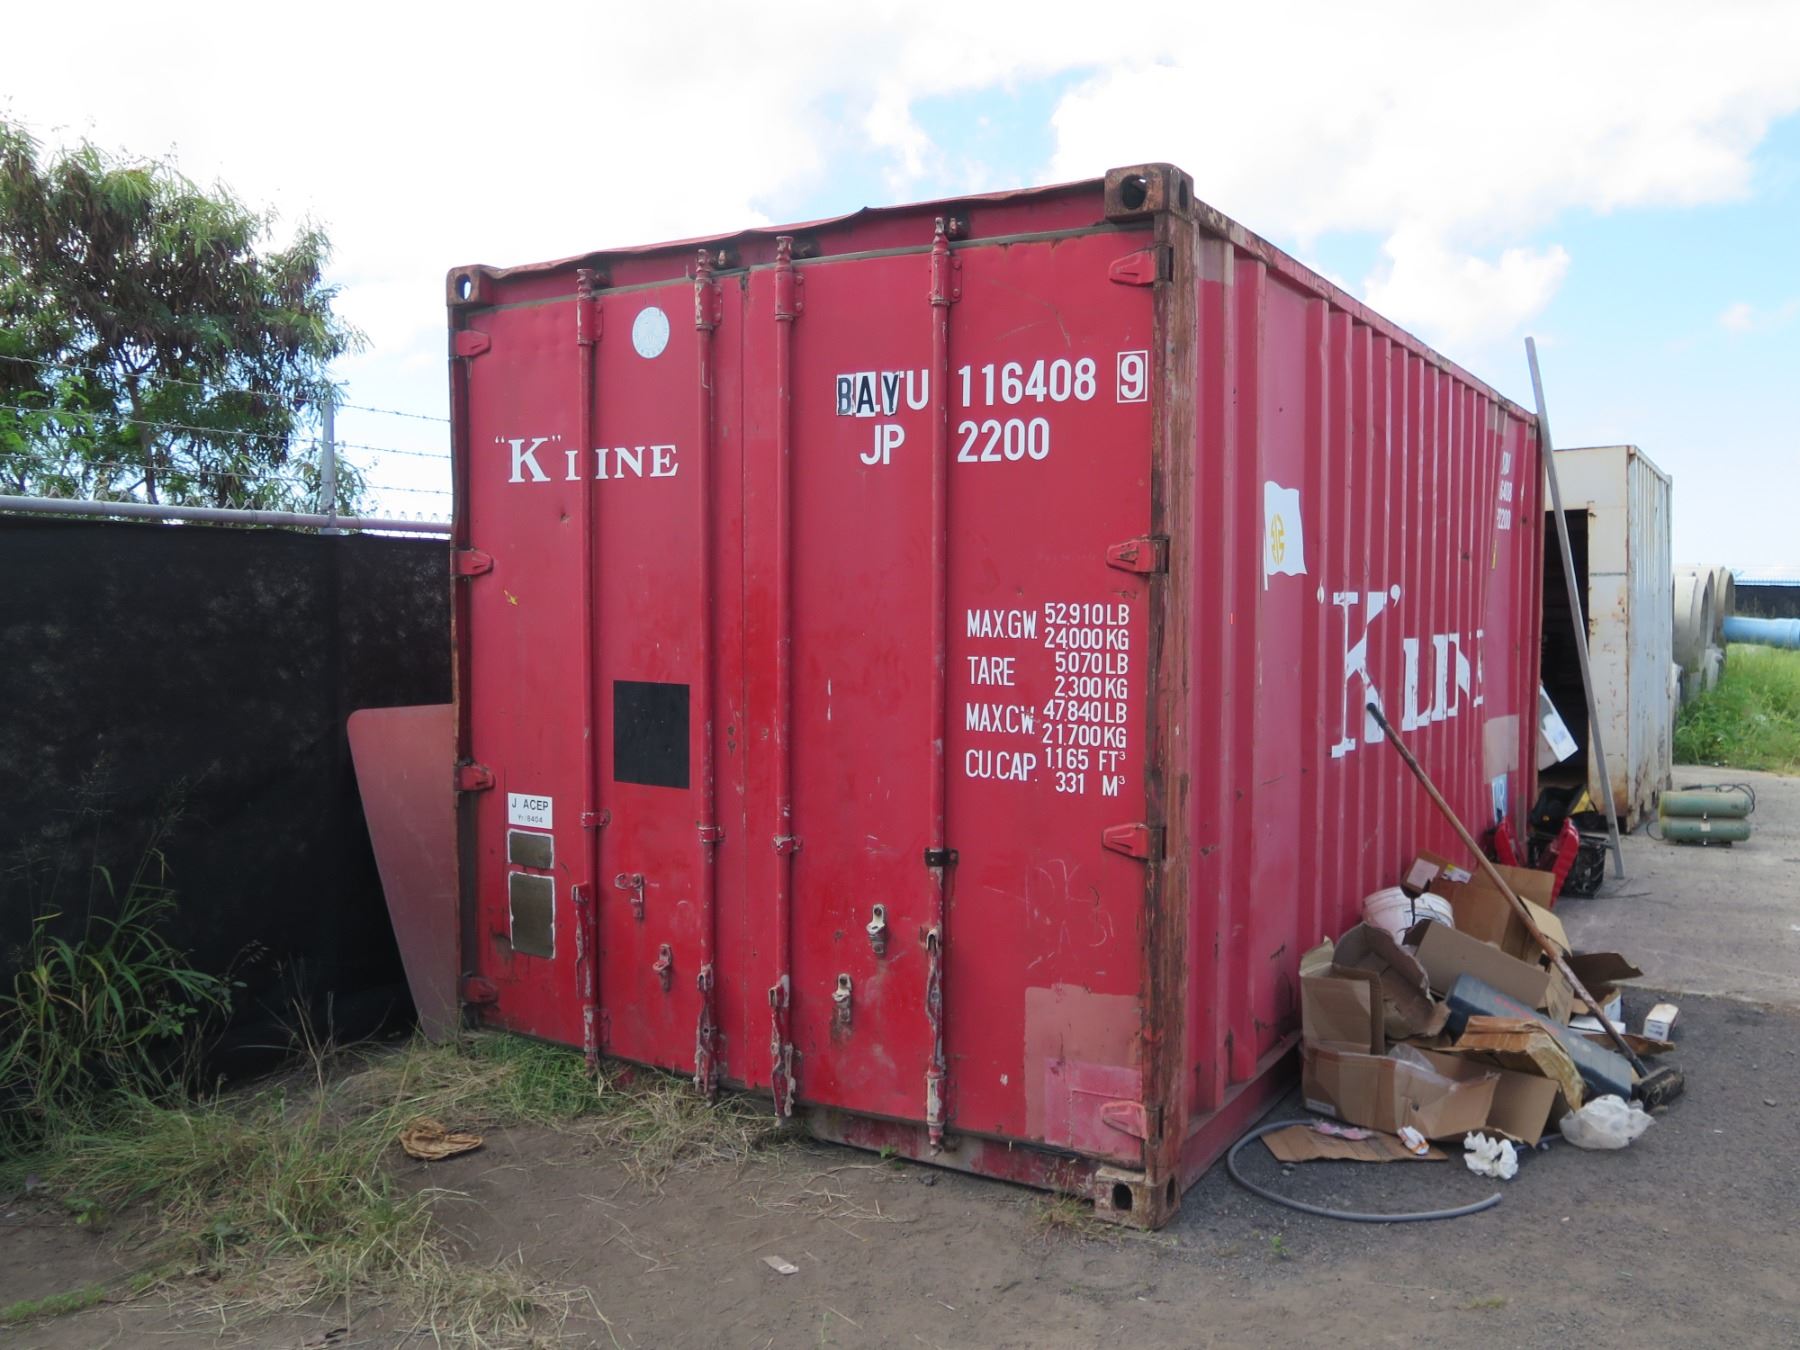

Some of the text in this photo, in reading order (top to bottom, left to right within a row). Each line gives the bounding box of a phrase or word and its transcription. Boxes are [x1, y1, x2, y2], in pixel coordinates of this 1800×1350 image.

[837, 354, 1146, 417] BAYU 116408 9
[860, 417, 1050, 465] JP 2200
[967, 656, 1016, 687] TARE
[523, 799, 549, 811] ACEP
